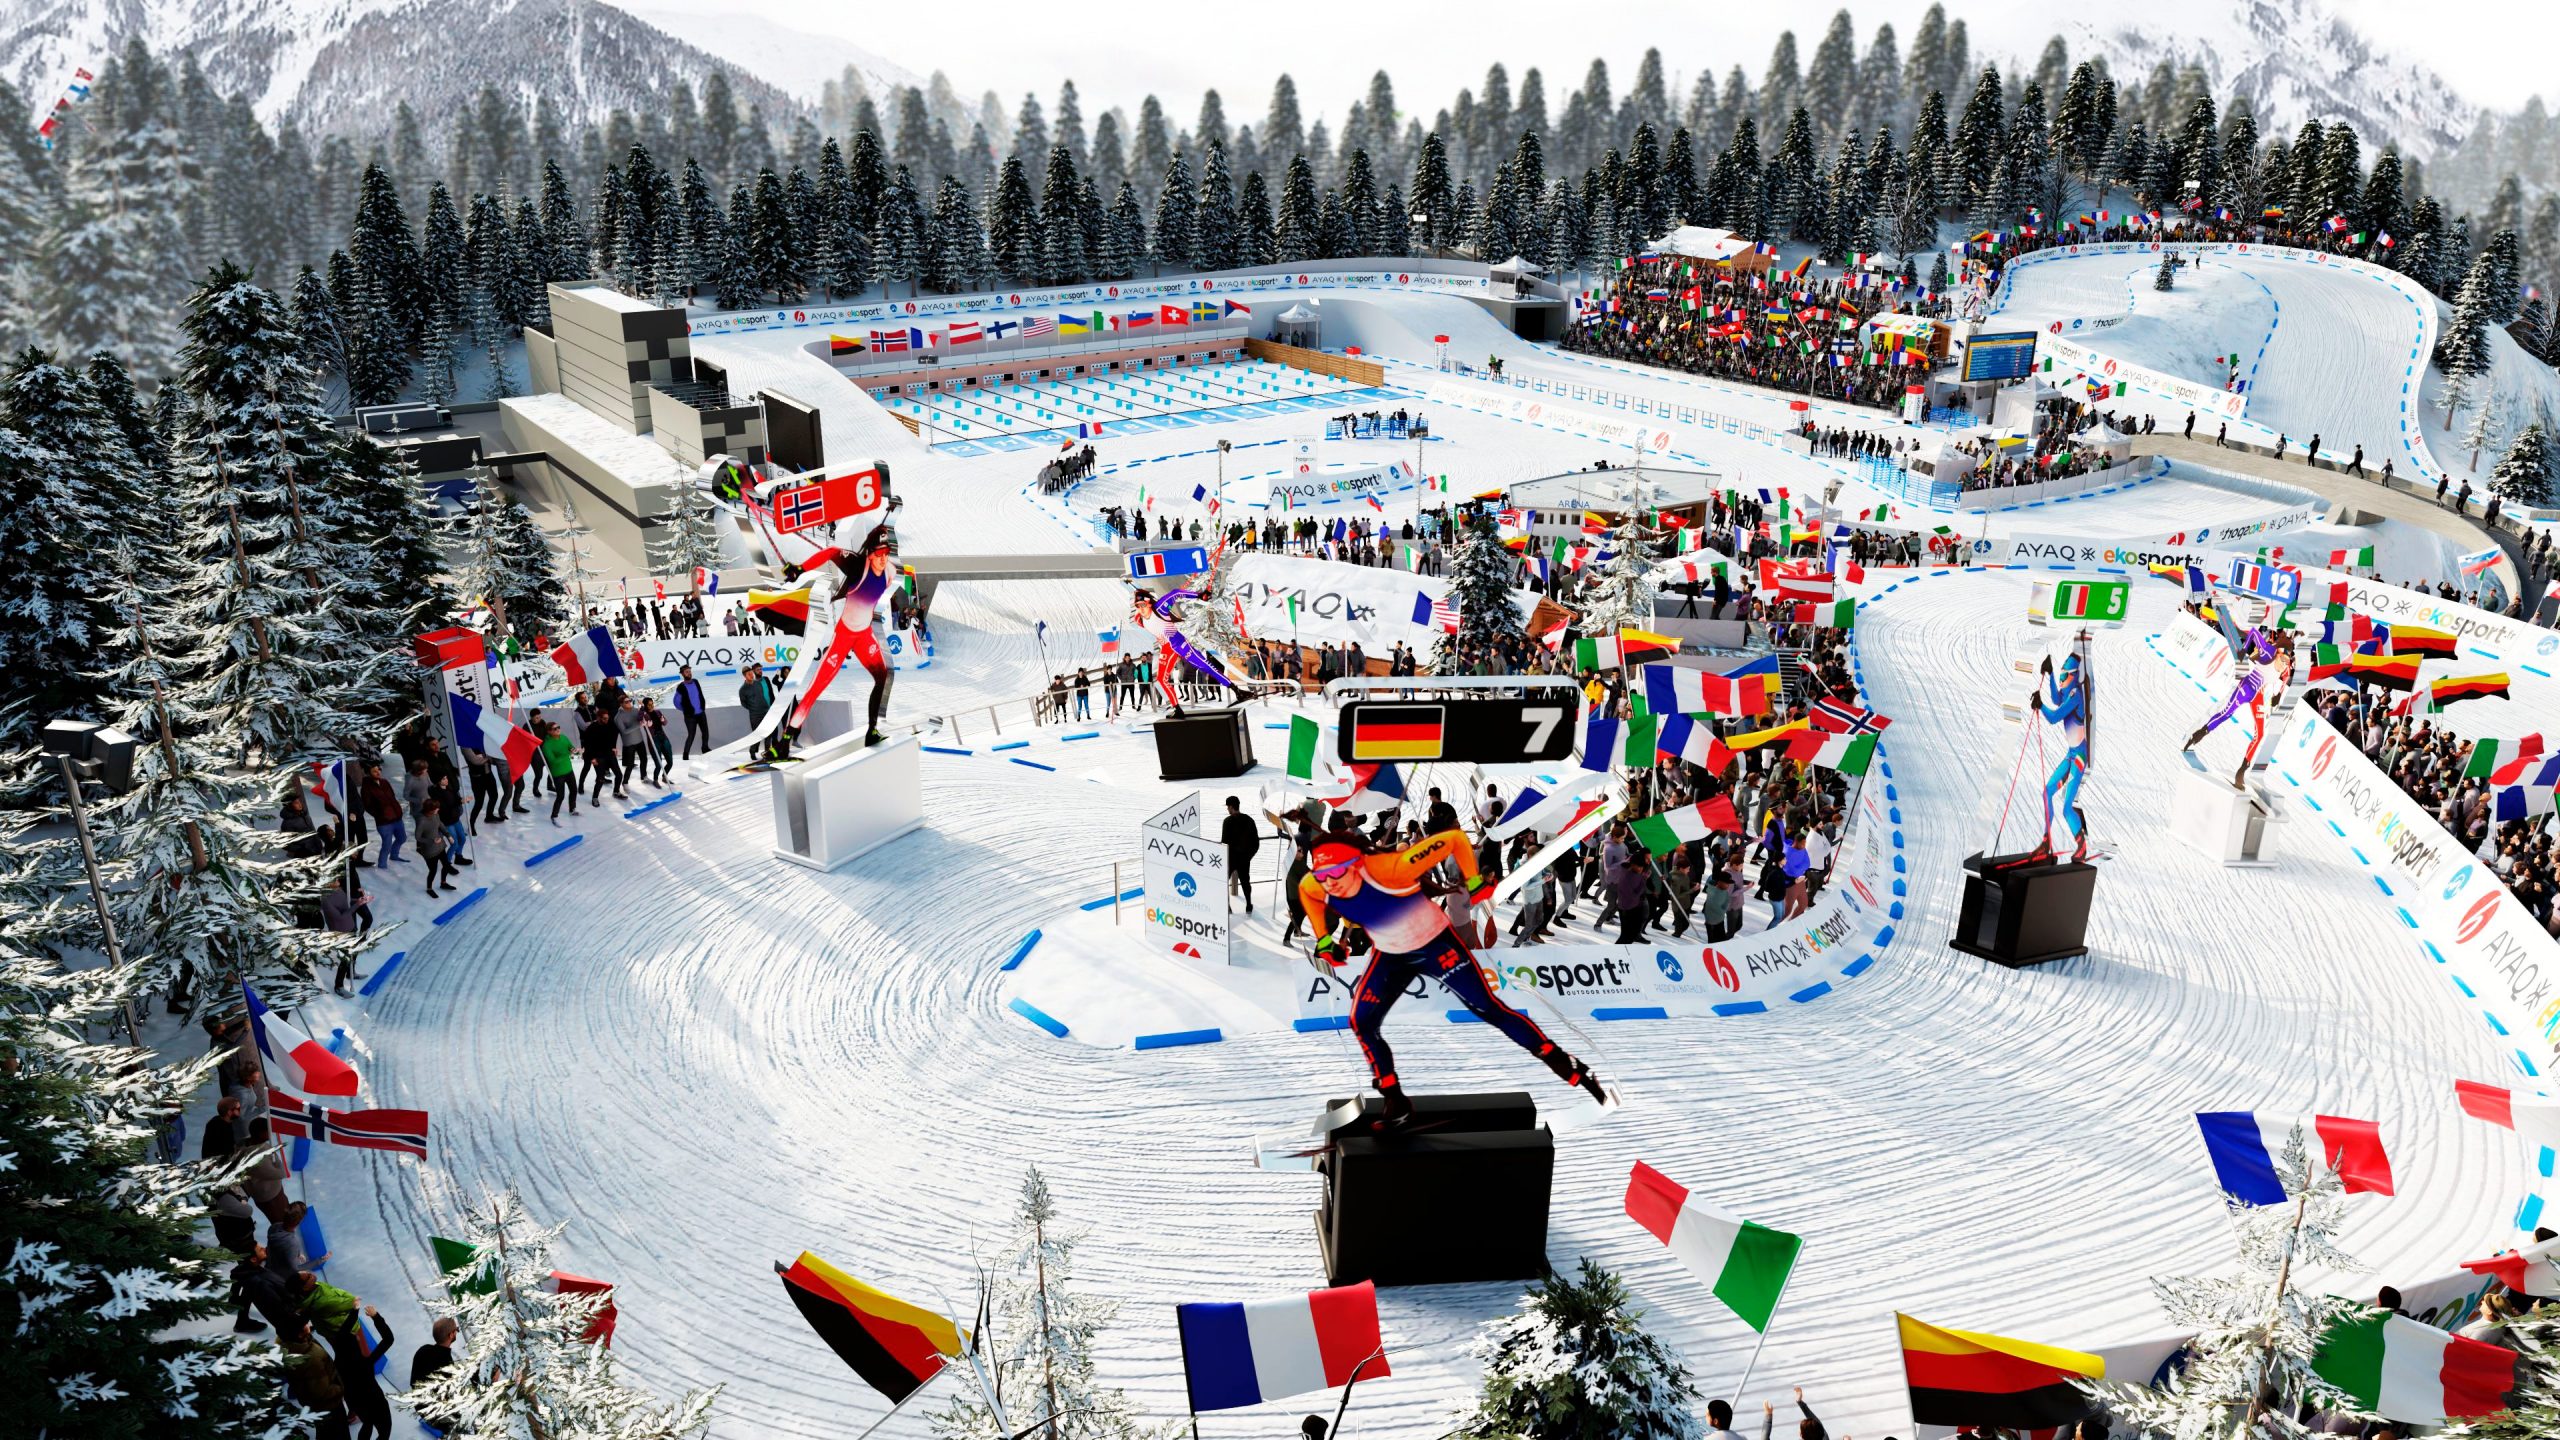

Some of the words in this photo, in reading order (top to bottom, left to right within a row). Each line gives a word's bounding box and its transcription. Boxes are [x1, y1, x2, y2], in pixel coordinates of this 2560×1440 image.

[1025, 294, 1048, 303] AYAQ
[1122, 287, 1145, 295] AYAQ
[811, 311, 838, 320] AYAQ
[921, 302, 946, 311] AYAQ
[696, 321, 722, 330] AYAQ
[855, 475, 875, 508] 6
[1271, 484, 1315, 498] AYAQ
[1191, 550, 1203, 570] 1
[2016, 543, 2076, 562] AYAQ
[2104, 547, 2204, 570] ekosport.fr
[2270, 571, 2292, 599] 12
[2106, 587, 2124, 615] 5
[662, 648, 732, 668] AYAQ
[1521, 707, 1563, 753] 7
[2330, 764, 2372, 816] AYAQ
[1147, 837, 1205, 867] AYAQ
[1147, 907, 1226, 940] ekosport.fr
[1746, 943, 1802, 978] AYAQ
[2482, 930, 2540, 1002] AYAQ
[1307, 974, 1429, 1002] AYQ
[1482, 957, 1632, 996] ekosport.fr
